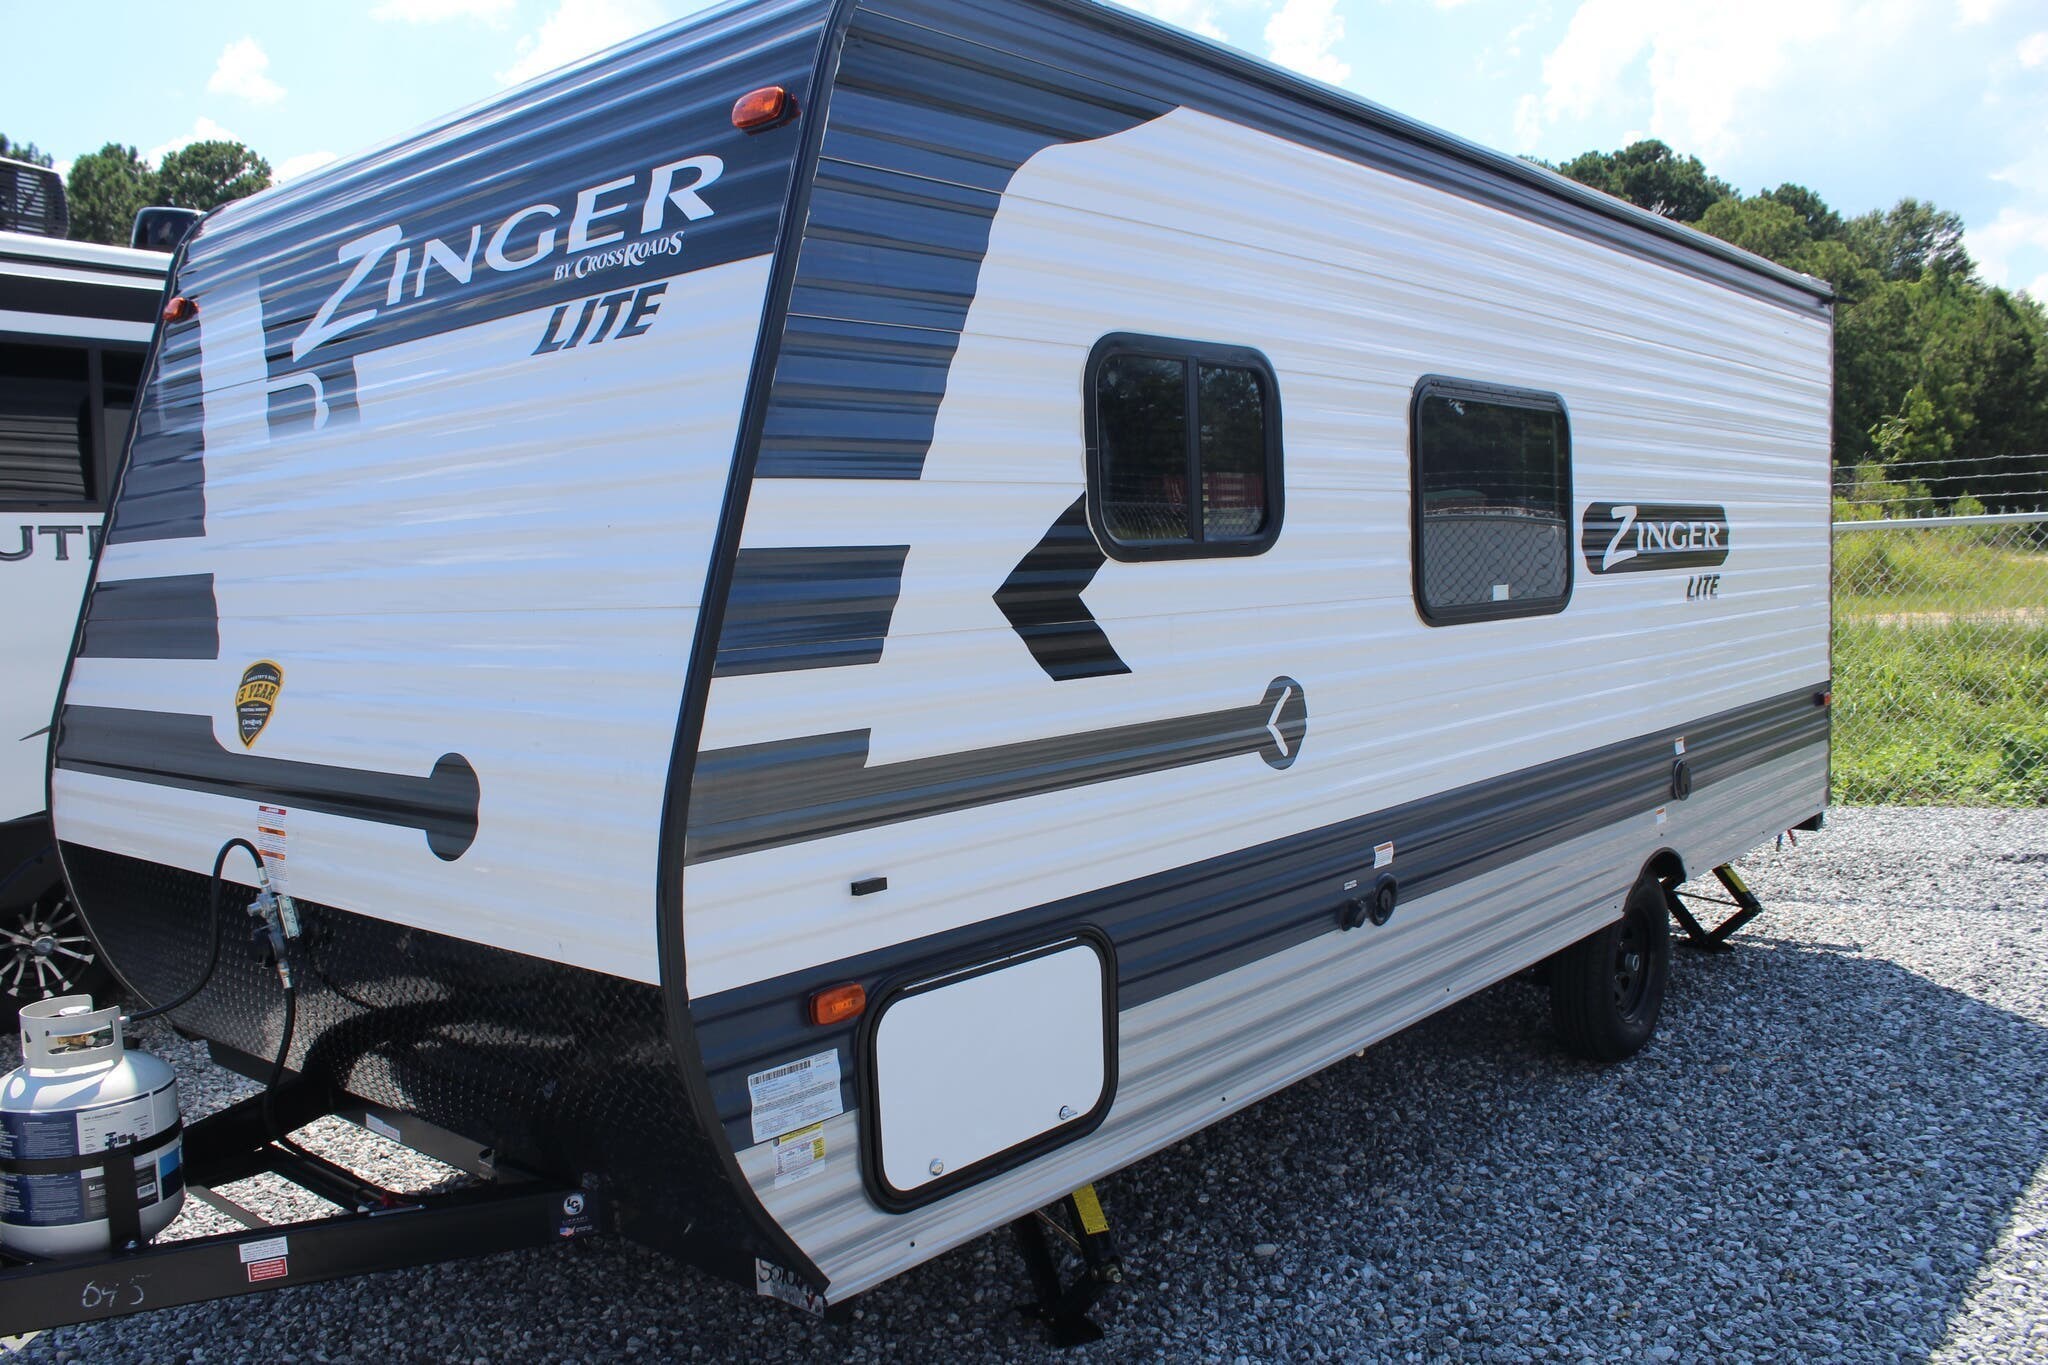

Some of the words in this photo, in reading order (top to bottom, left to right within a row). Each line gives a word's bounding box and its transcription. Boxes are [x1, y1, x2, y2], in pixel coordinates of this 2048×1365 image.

[292, 154, 724, 363] ZINGER
[554, 262, 574, 280] BY
[531, 282, 669, 356] LITE
[1602, 505, 1720, 571] ZINGER
[1686, 574, 1720, 599] LITE
[238, 687, 246, 702] 3
[248, 683, 276, 701] YEAR
